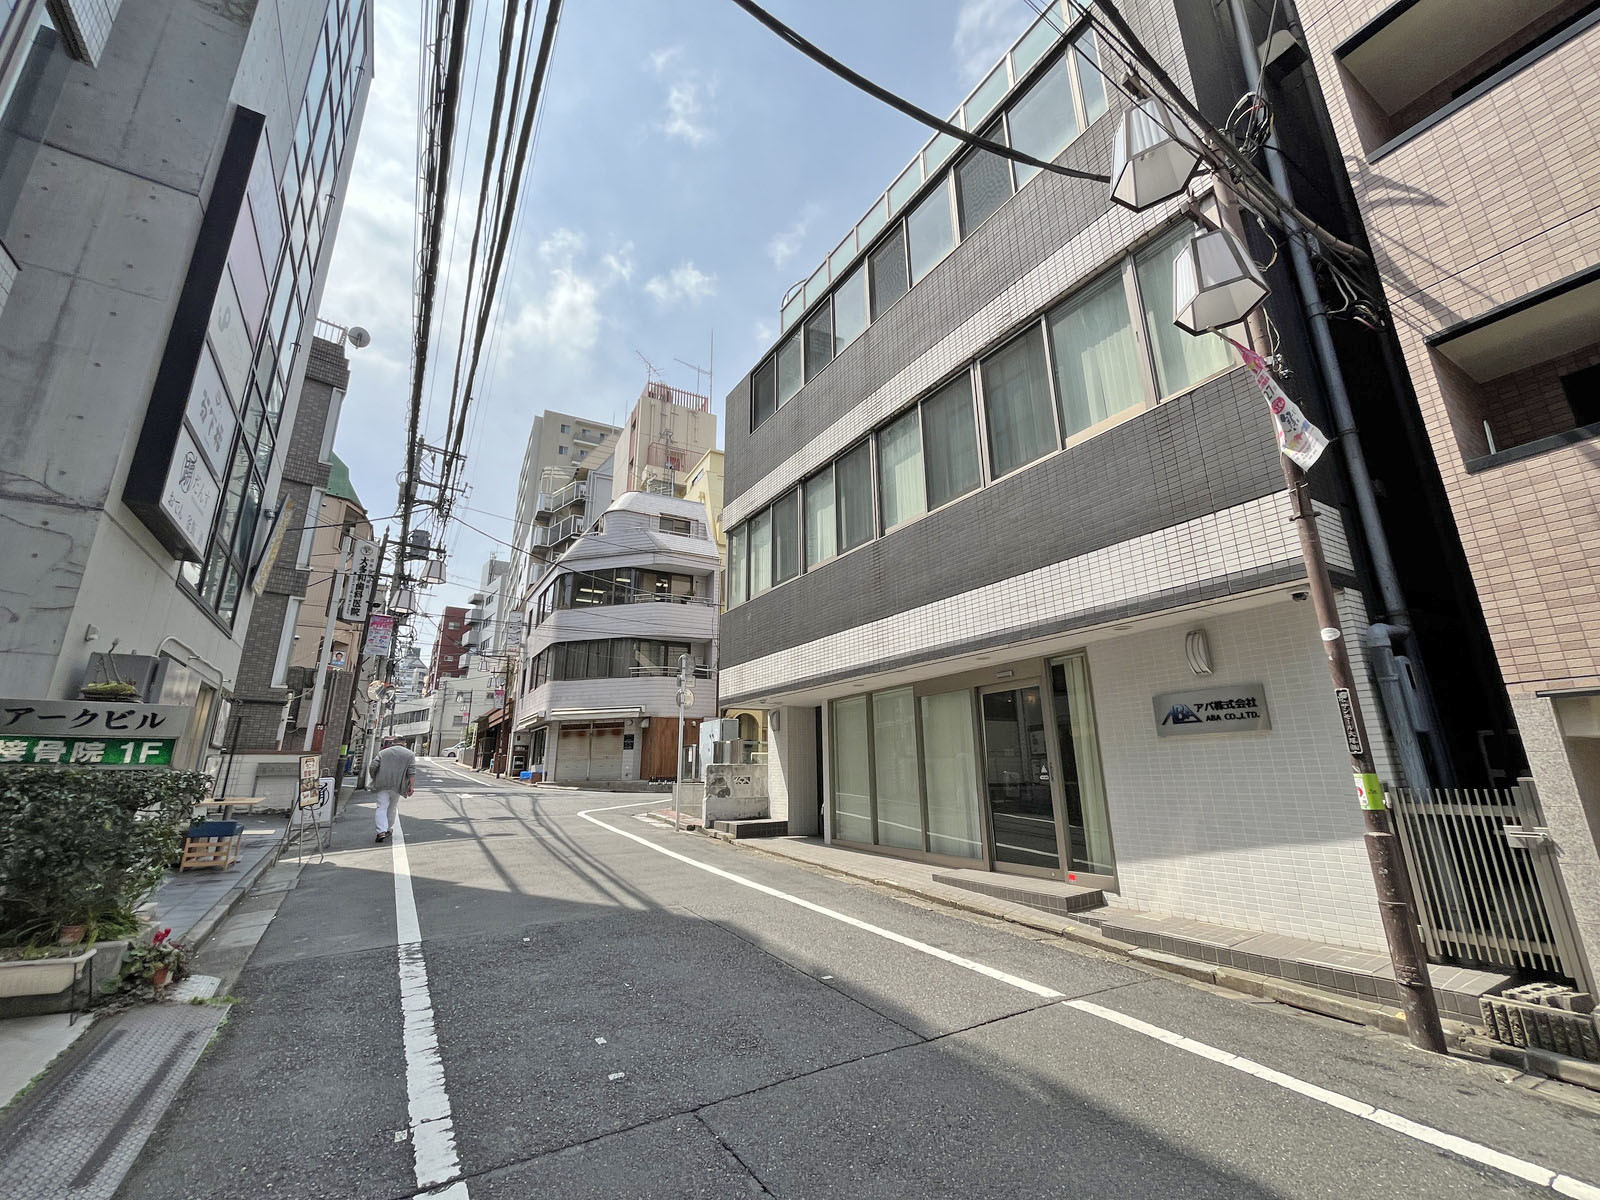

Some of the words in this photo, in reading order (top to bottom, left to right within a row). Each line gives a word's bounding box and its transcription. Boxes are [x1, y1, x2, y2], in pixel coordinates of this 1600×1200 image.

[4, 707, 166, 731] アークビル
[1206, 714, 1222, 722] ABA
[0, 739, 106, 764] 接骨院
[120, 741, 163, 764] 1F
